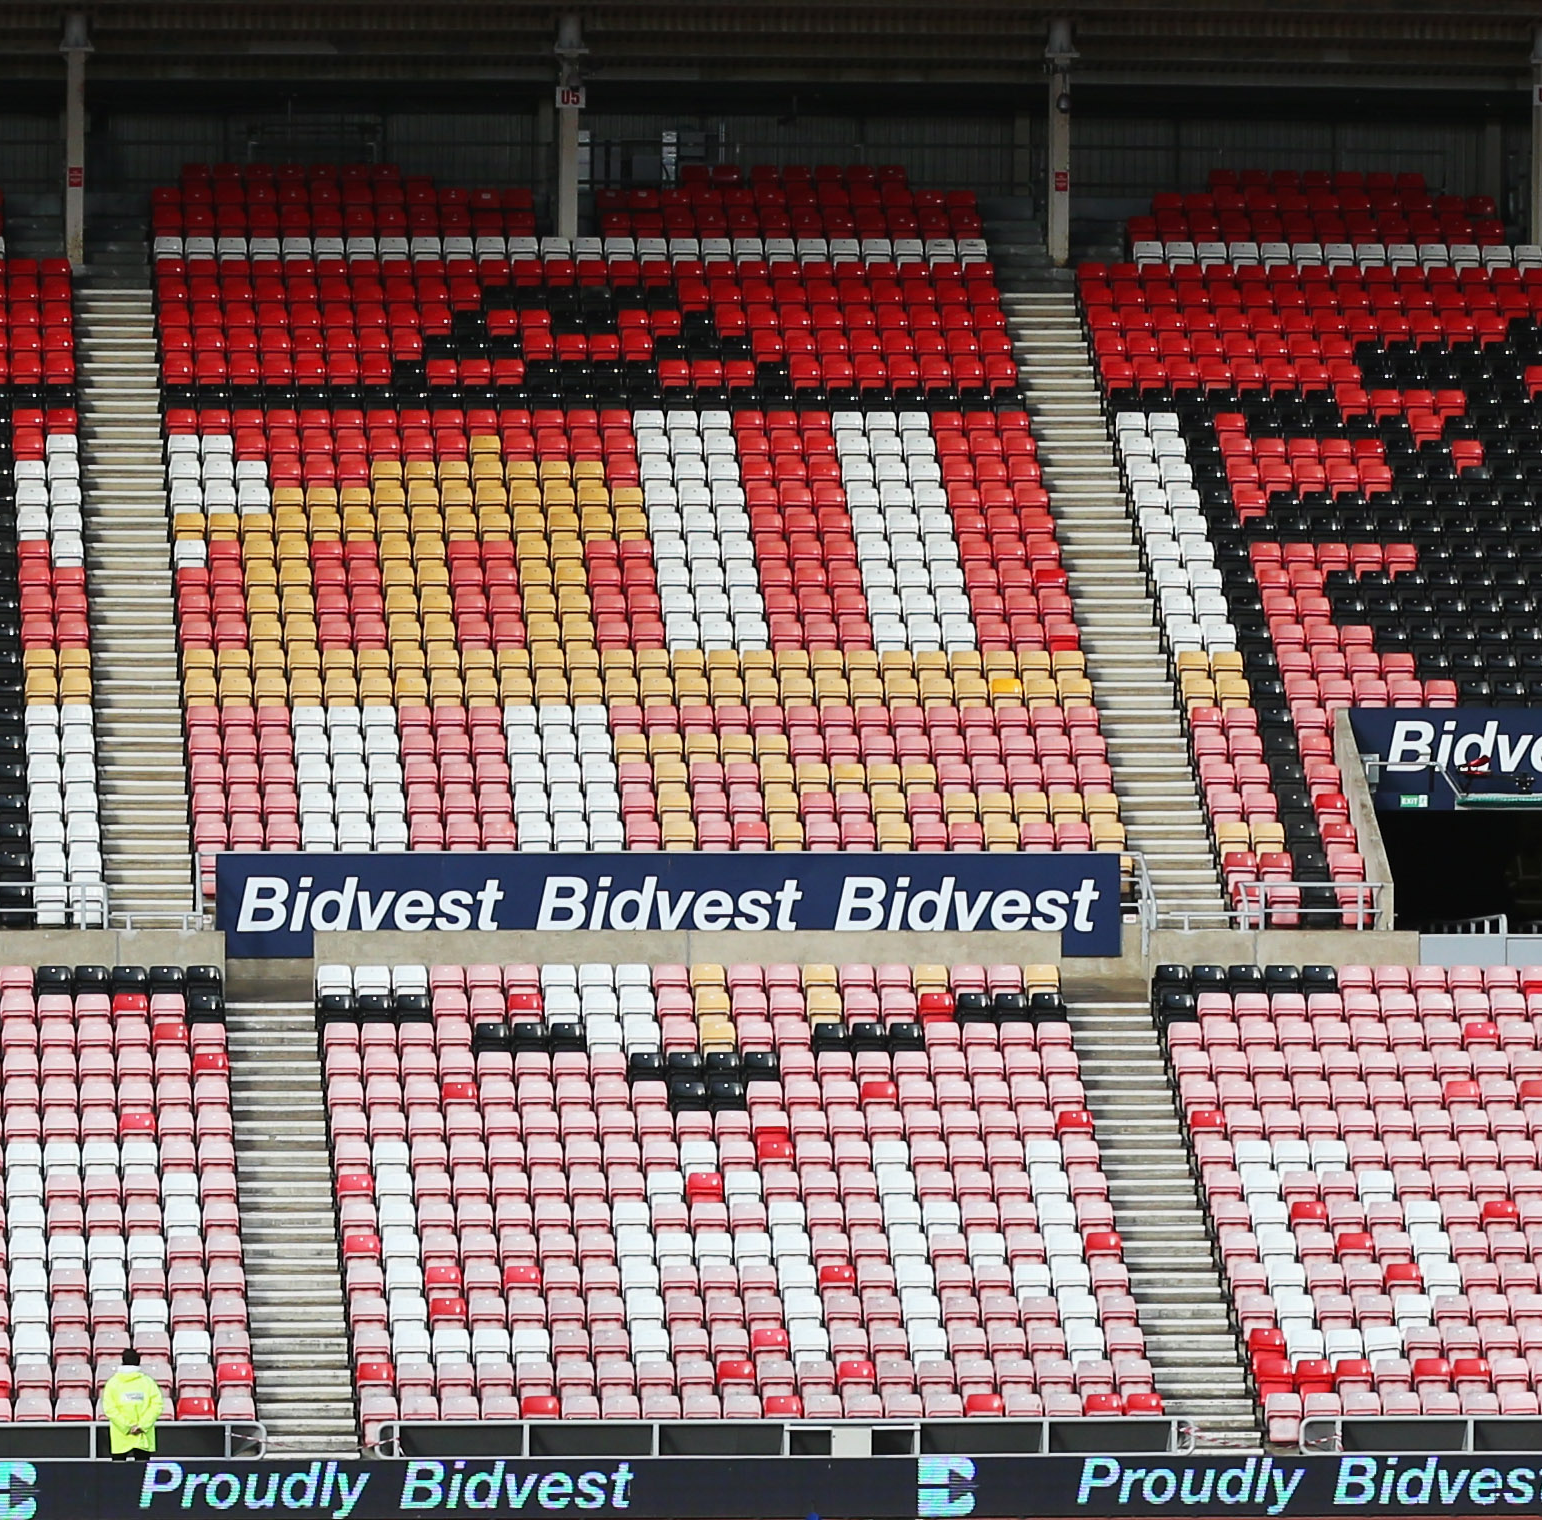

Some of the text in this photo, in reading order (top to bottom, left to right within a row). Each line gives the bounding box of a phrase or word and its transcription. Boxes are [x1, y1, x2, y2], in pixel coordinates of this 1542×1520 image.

[561, 89, 581, 105] U5
[236, 876, 1100, 933] Bidvest Bidvest Bidvest
[139, 1461, 371, 1519] Proudly
[400, 1460, 634, 1510] Bidvest
[1077, 1456, 1305, 1516] Proudly
